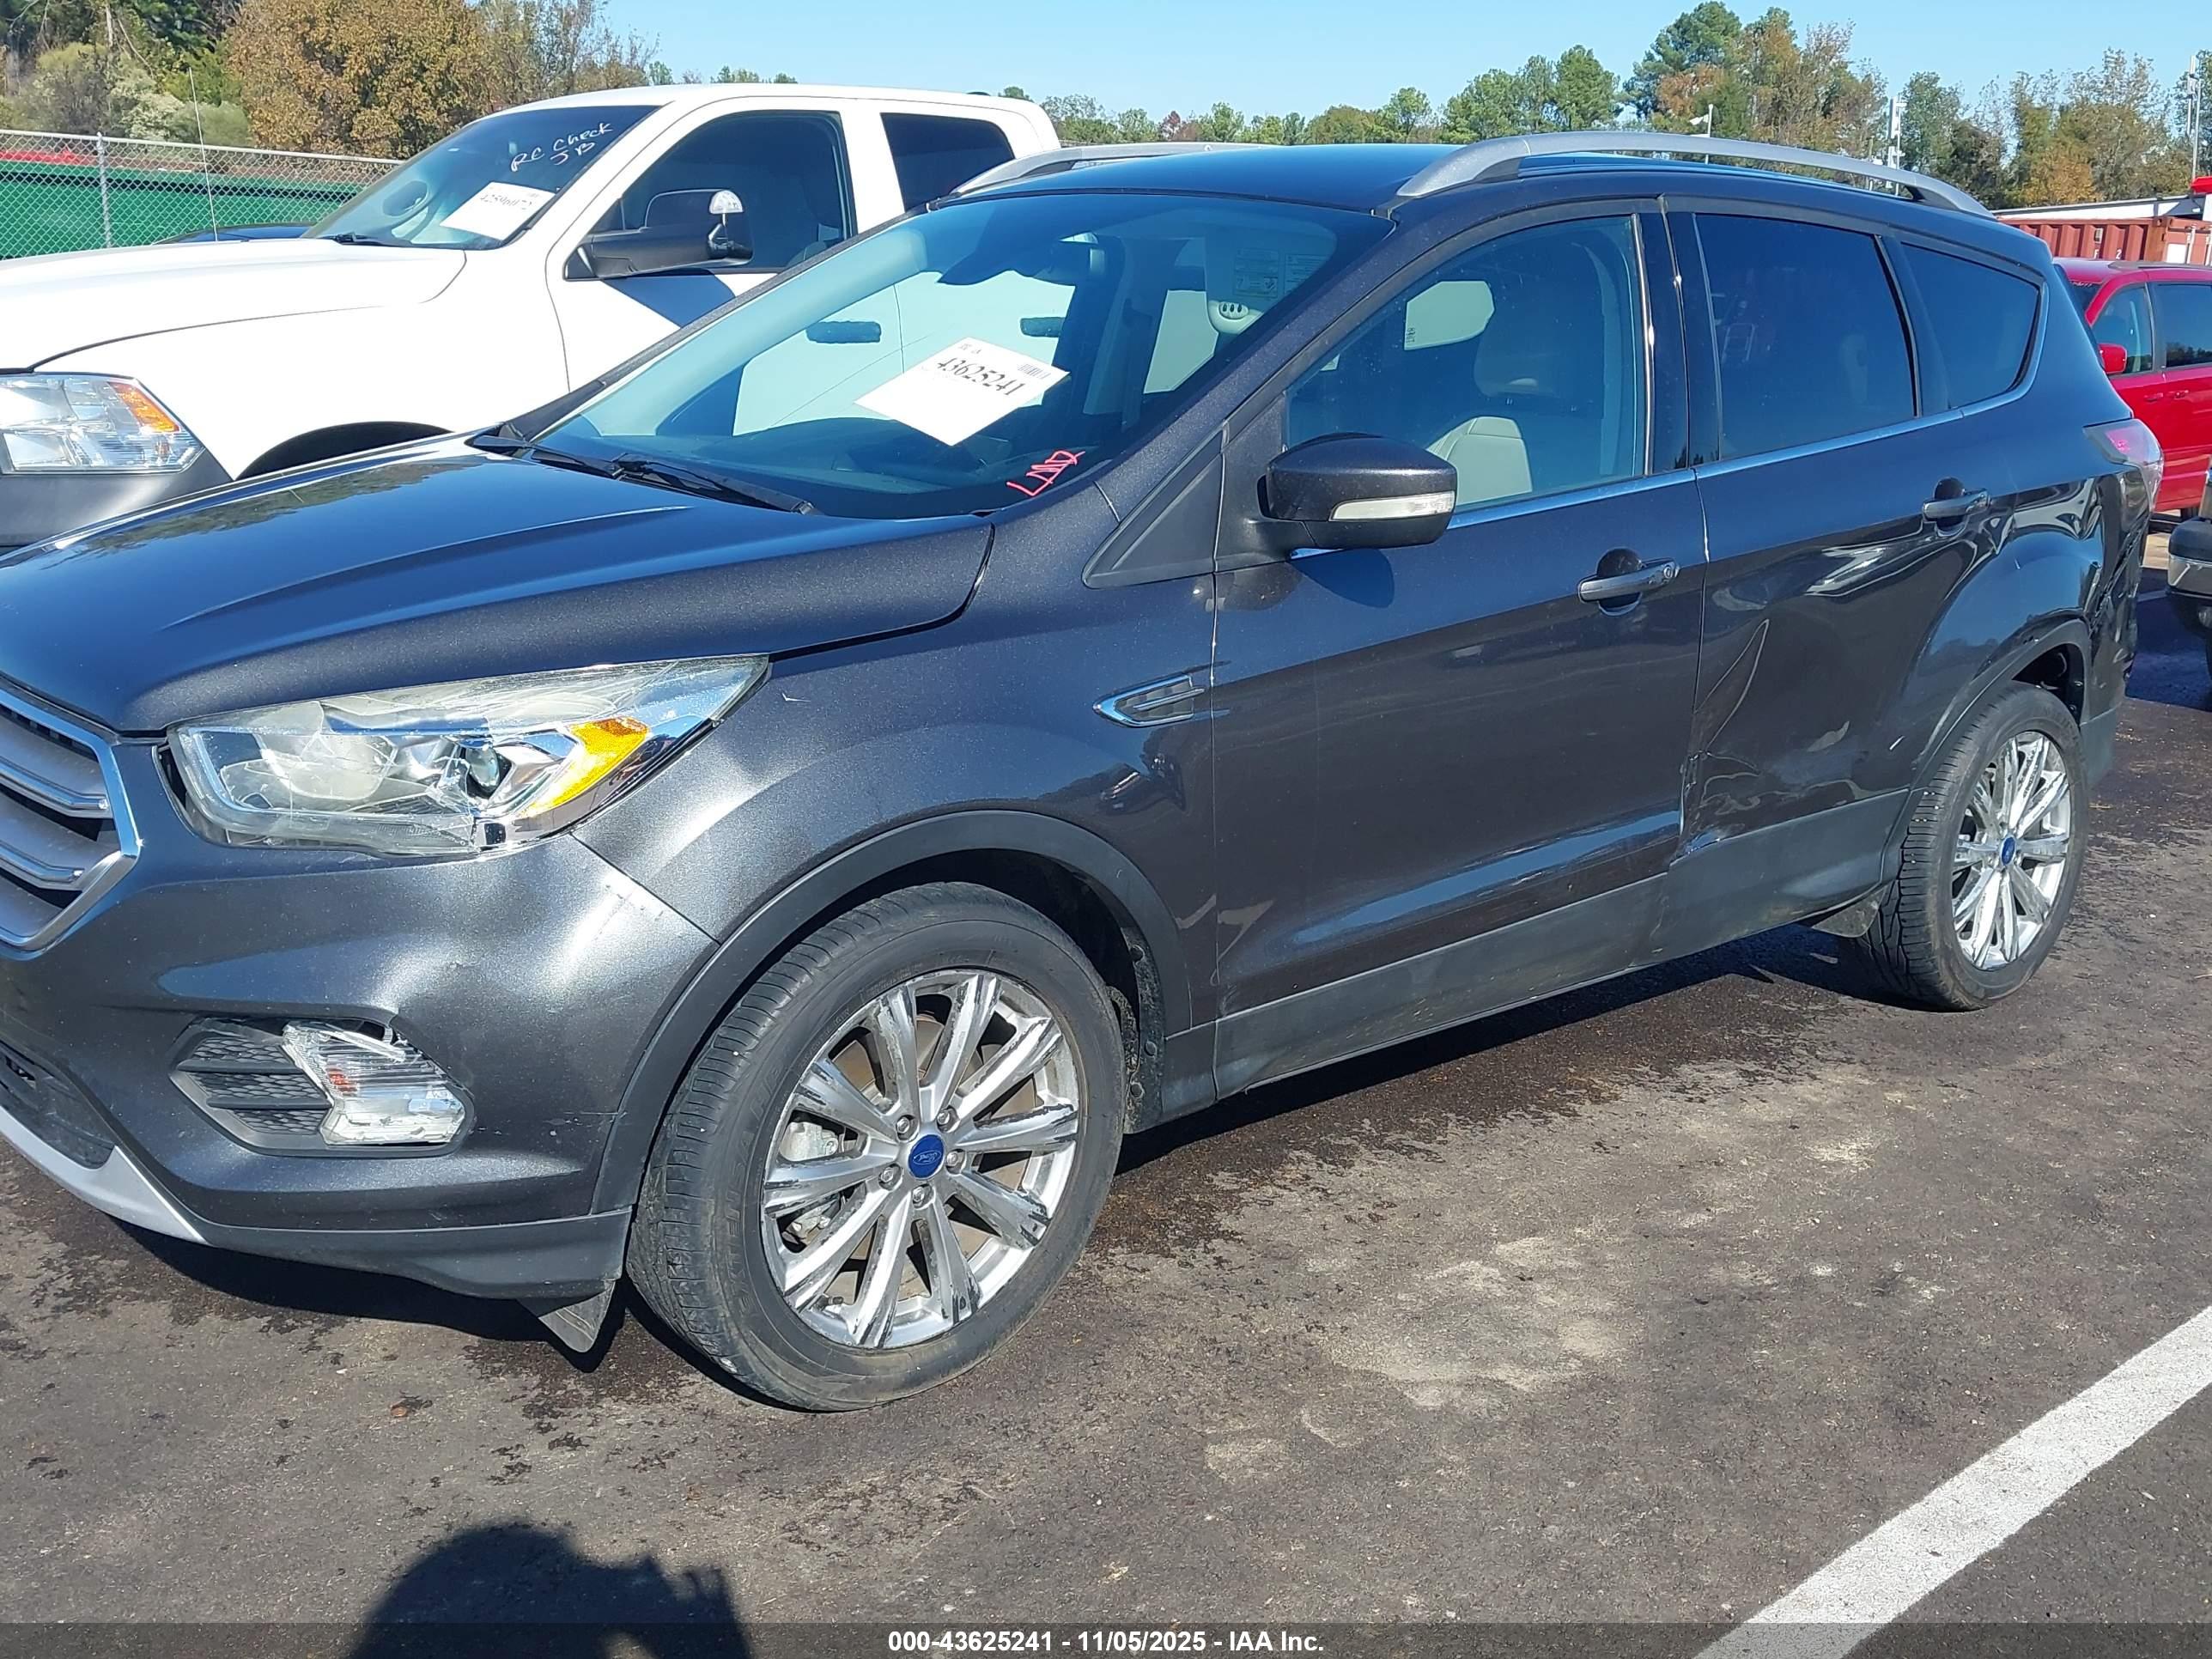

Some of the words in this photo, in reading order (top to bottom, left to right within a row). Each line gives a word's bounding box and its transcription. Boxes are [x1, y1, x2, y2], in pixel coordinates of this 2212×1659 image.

[510, 147, 545, 172] RC
[553, 123, 613, 151] Check
[937, 356, 1026, 396] 43625241
